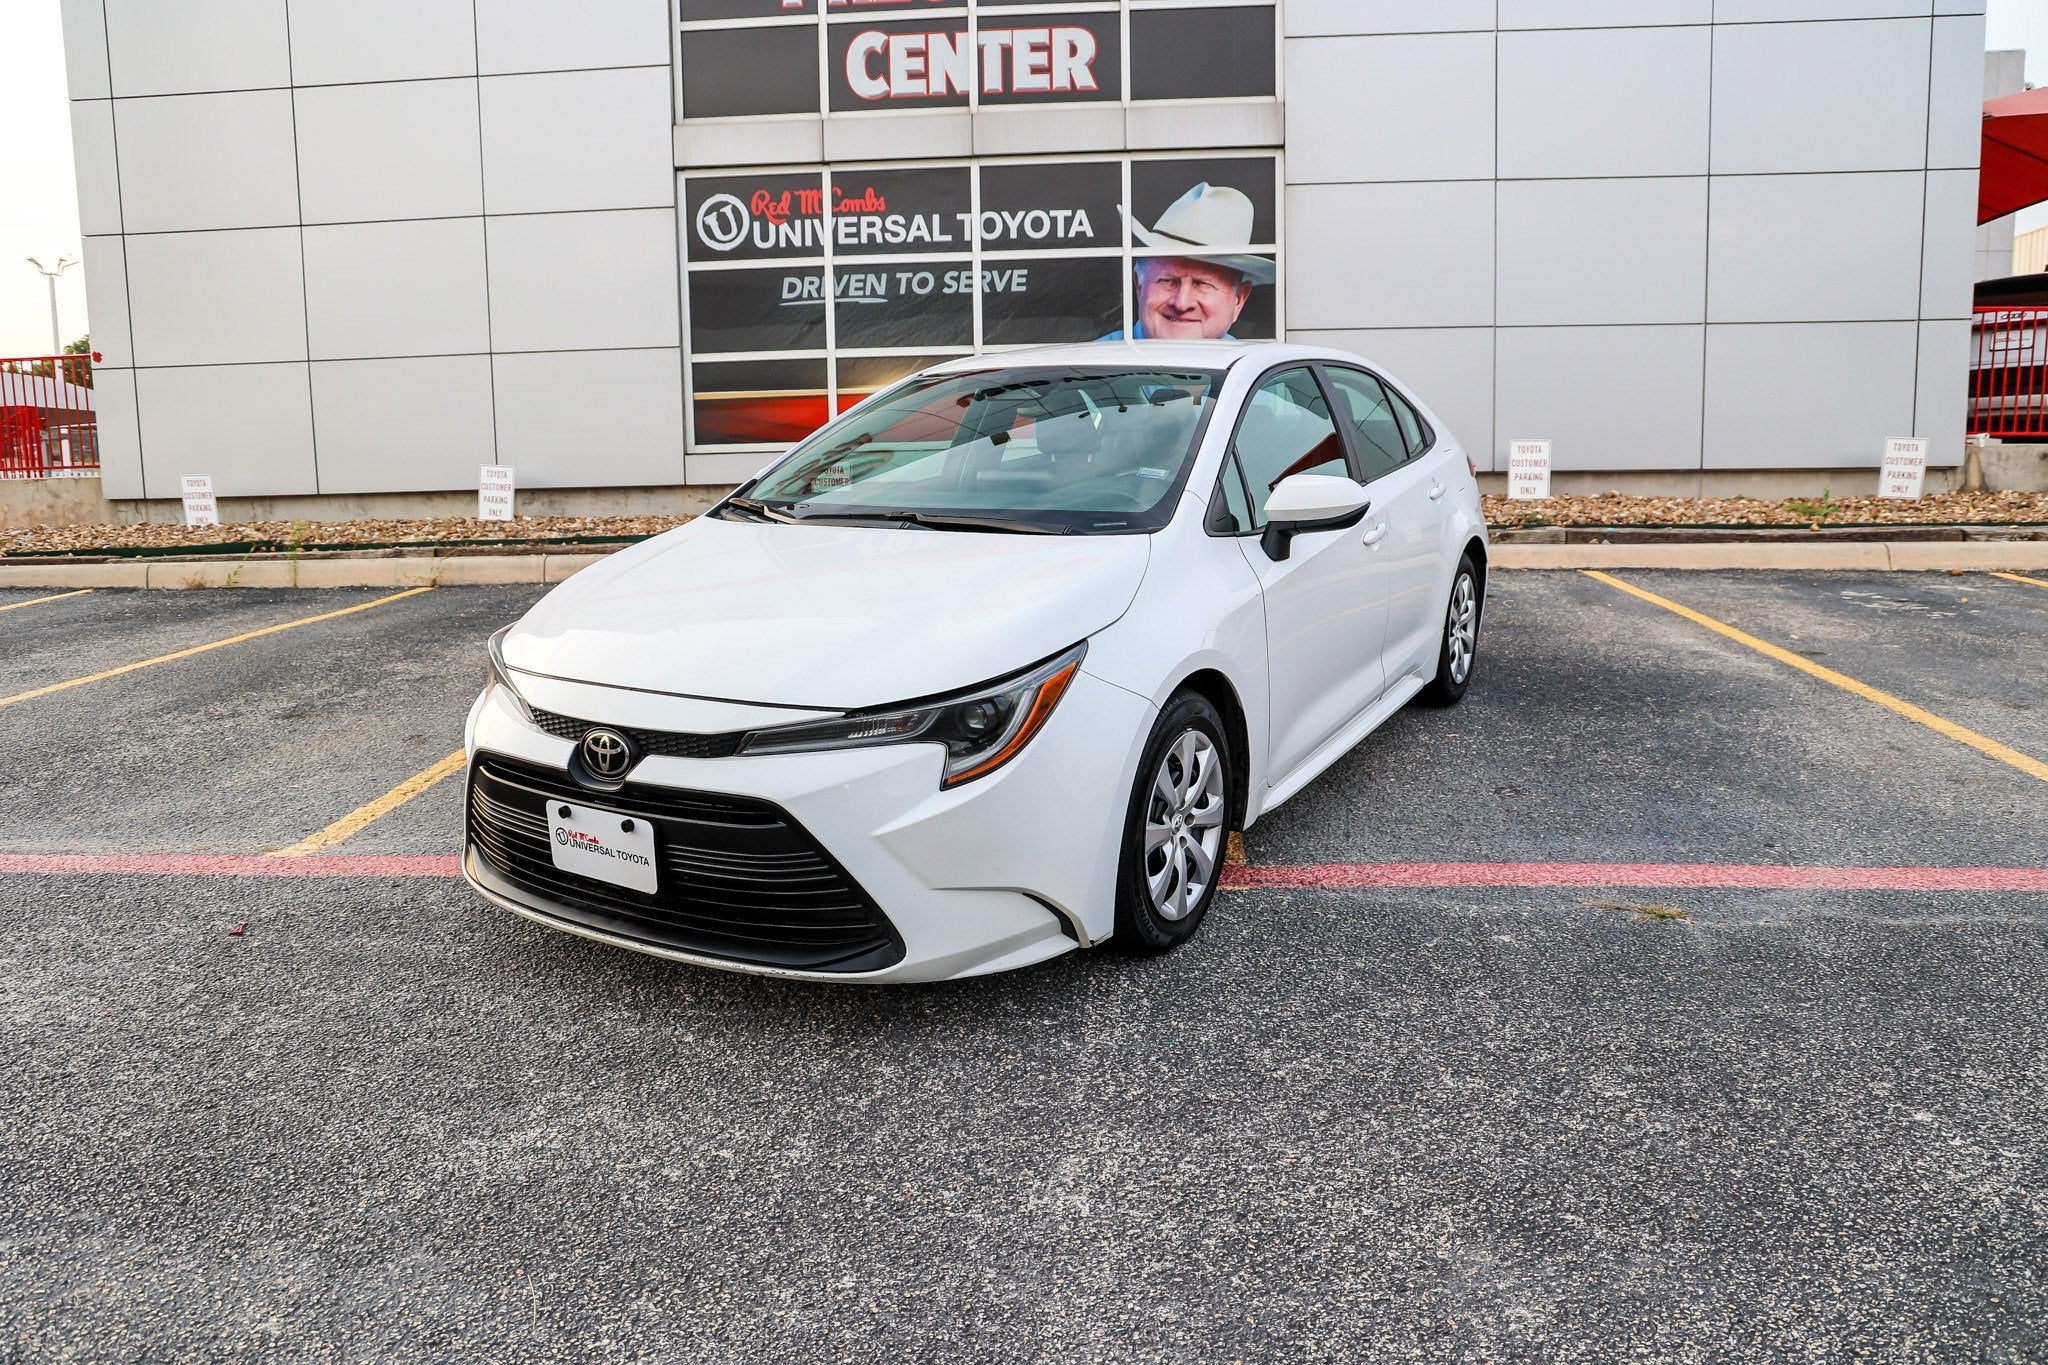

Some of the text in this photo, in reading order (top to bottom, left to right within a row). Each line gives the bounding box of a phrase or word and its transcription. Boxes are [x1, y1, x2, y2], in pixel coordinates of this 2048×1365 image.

[846, 27, 1098, 99] CENTER
[751, 189, 791, 225] Red
[753, 209, 1094, 249] UNIVERSAL TOYOTA
[896, 270, 935, 296] TO
[942, 269, 1028, 294] SERVE
[1518, 445, 1542, 453] TOYOTA
[1894, 443, 1918, 451] TOYOTA
[1511, 459, 1547, 467] CUSTOMER
[1886, 457, 1923, 466] CUSTOMER
[487, 470, 507, 478] TOYOTA
[825, 466, 844, 474] OYOTA
[1888, 471, 1917, 479] PARKING
[814, 478, 849, 486] CUSTOMER
[481, 483, 511, 491] CUSTOMER
[1892, 485, 1908, 493] ONLY
[484, 496, 508, 504] PARKING
[569, 839, 649, 866] UNIVERSAL TOYOTA
